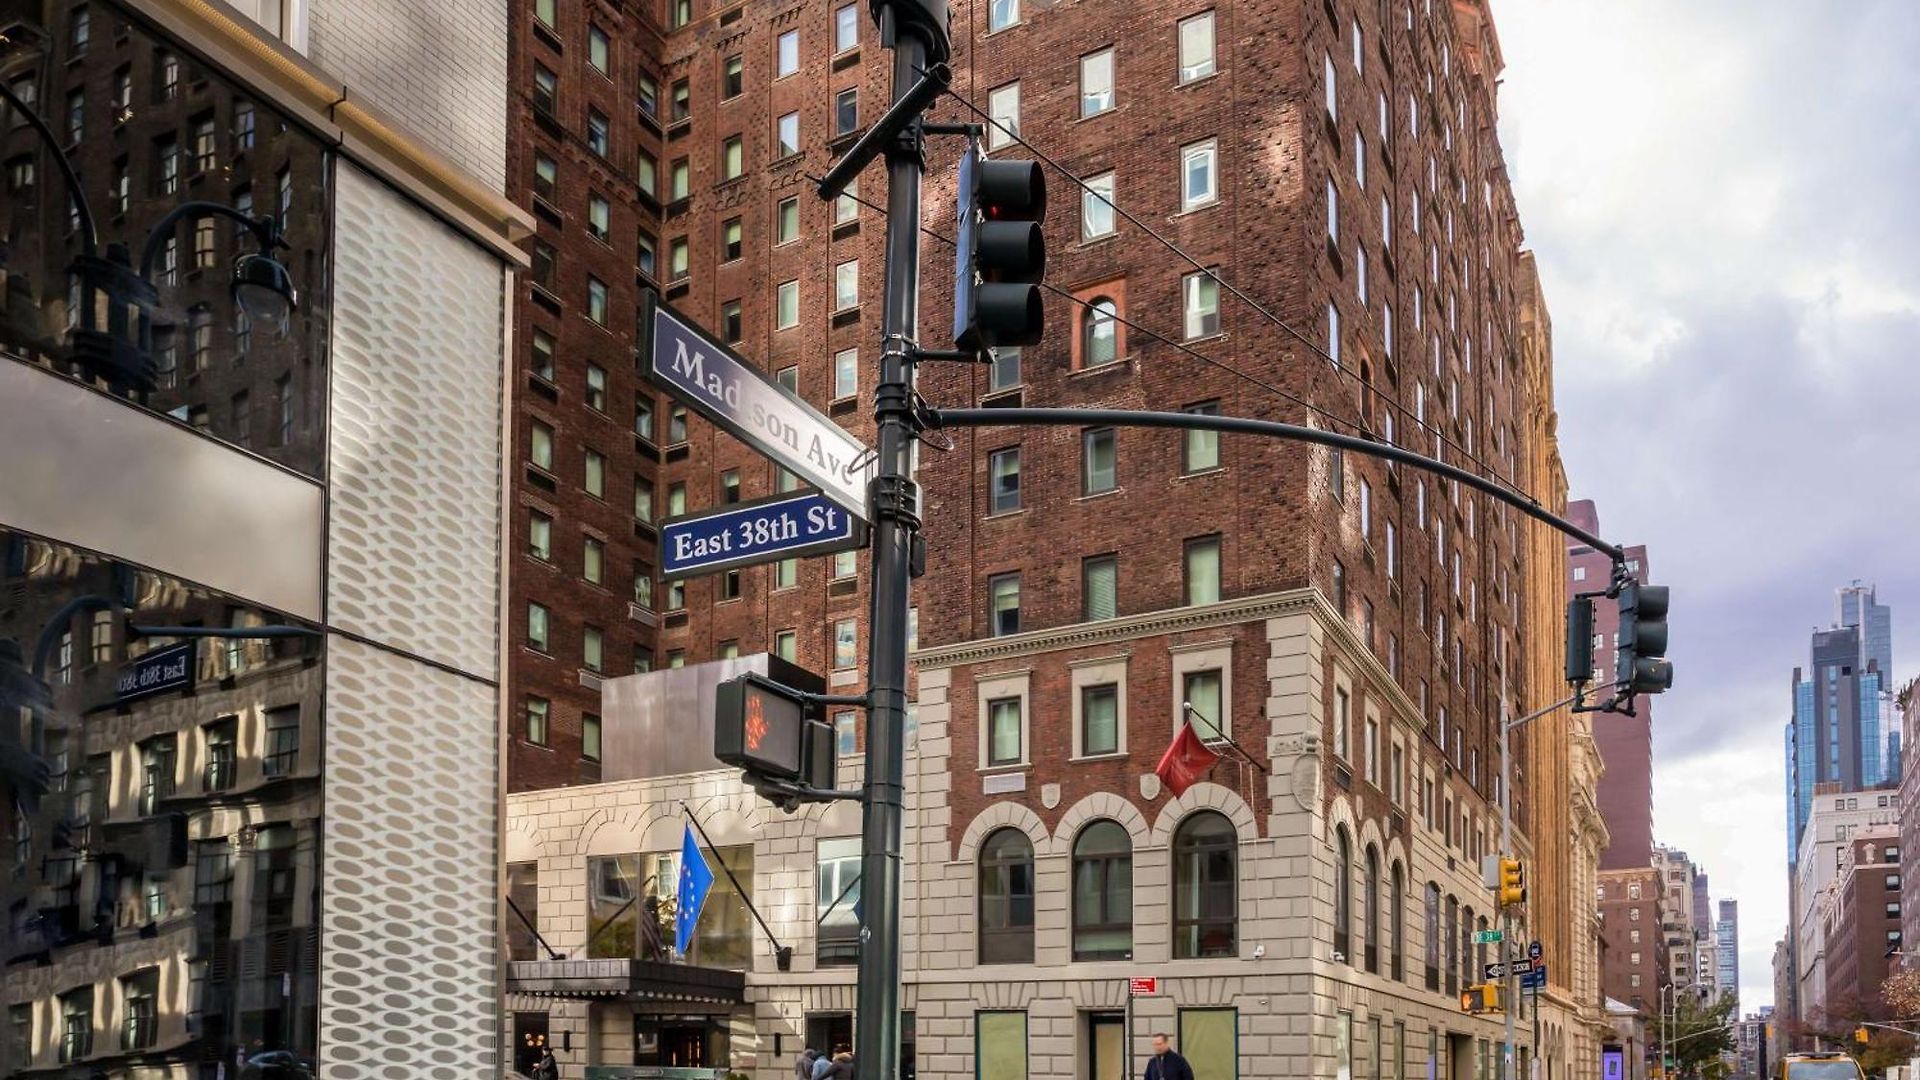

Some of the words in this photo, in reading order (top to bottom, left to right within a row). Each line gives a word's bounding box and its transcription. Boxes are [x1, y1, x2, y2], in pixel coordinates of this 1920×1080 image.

[671, 338, 800, 452] Madson
[807, 433, 854, 485] Ave
[674, 531, 732, 561] East
[739, 513, 798, 548] 38th
[807, 505, 837, 534] St
